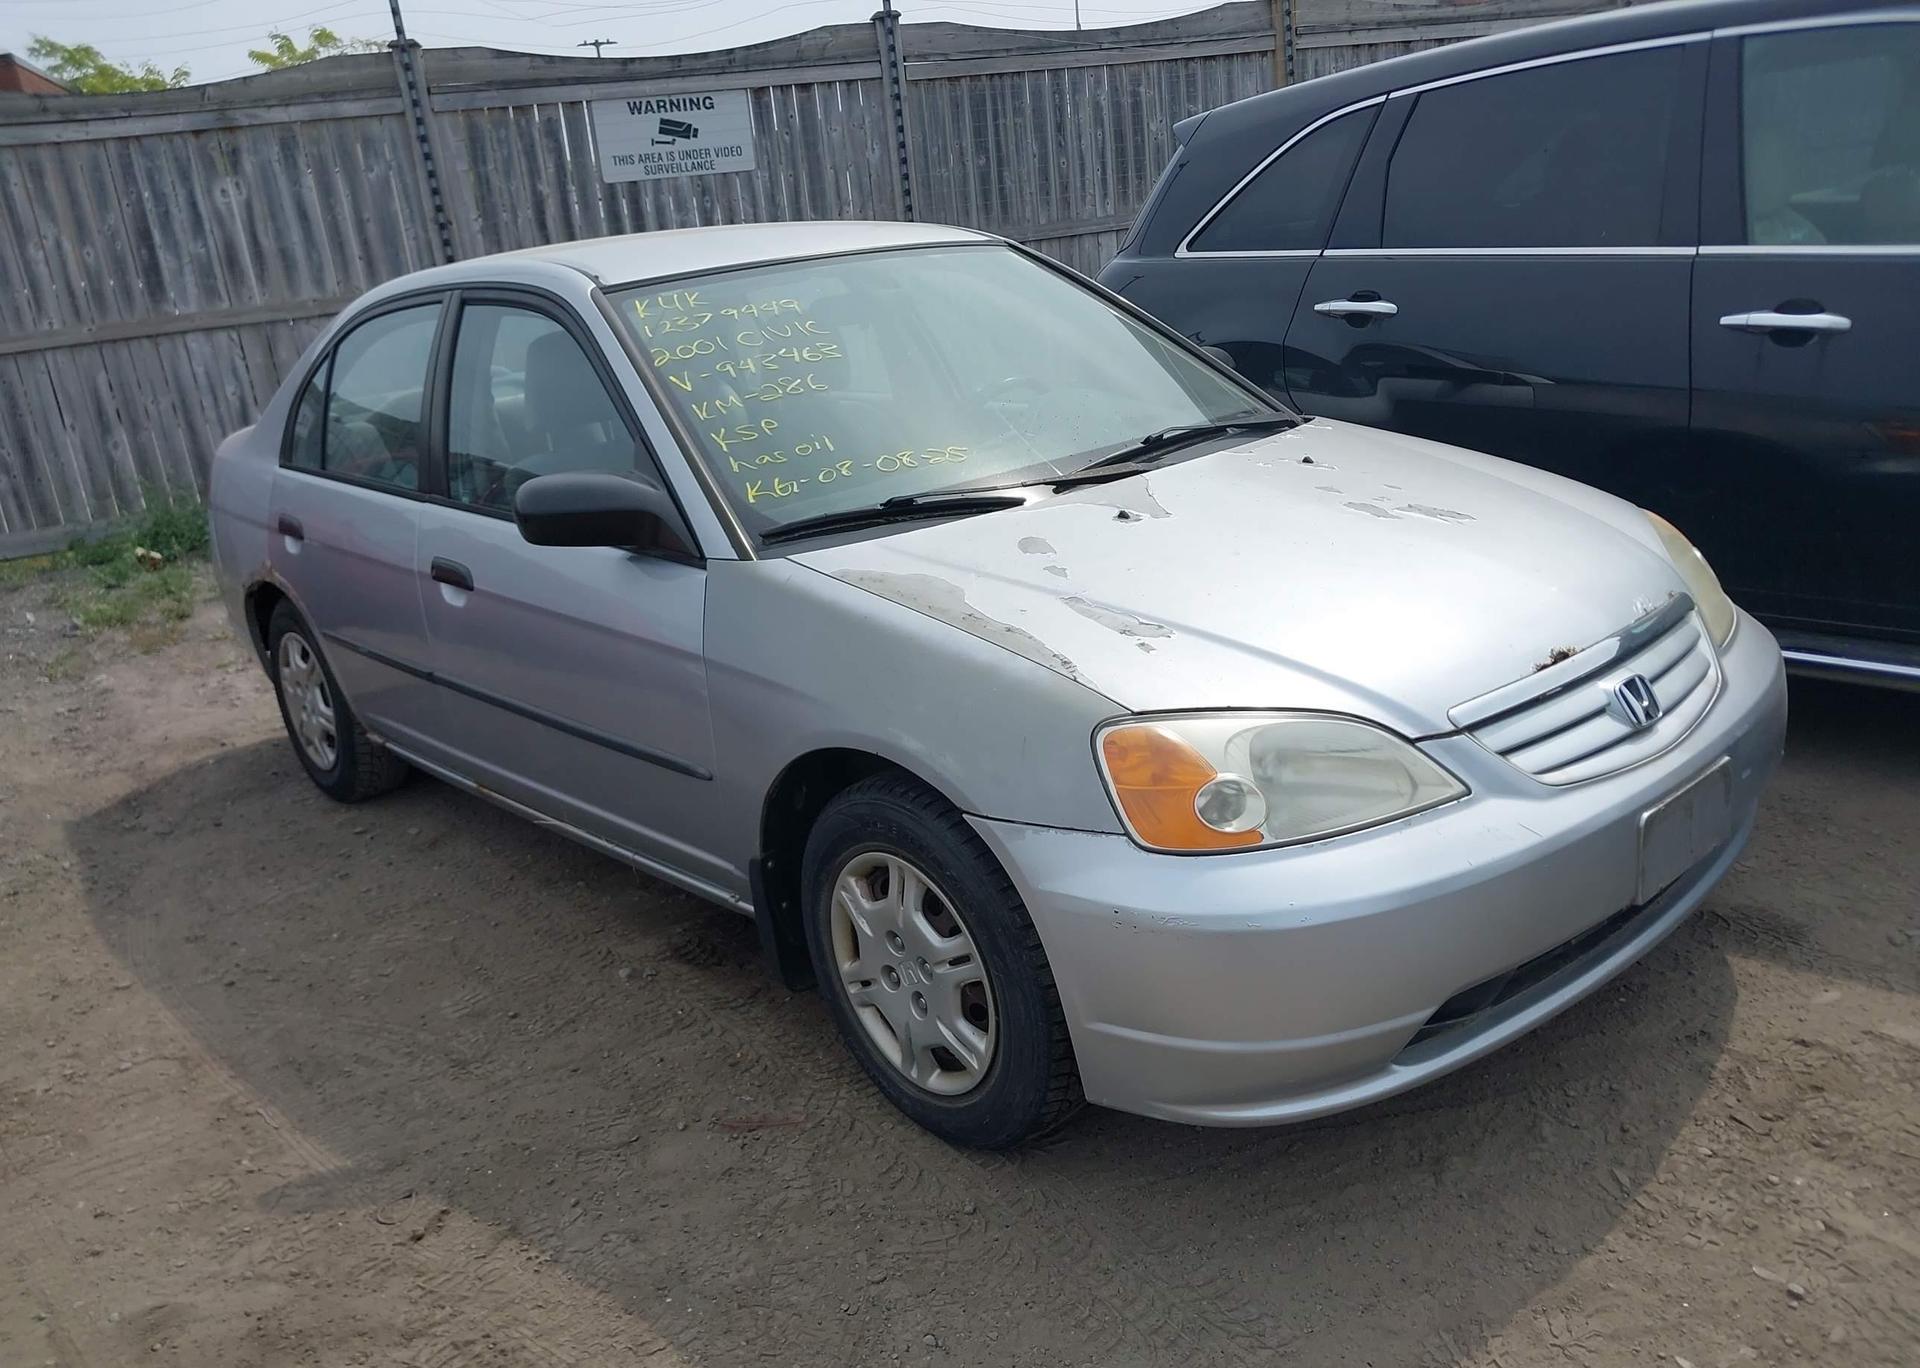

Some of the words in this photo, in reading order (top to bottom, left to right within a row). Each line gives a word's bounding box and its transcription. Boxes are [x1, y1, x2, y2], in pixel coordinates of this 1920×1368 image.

[627, 96, 715, 115] WARNING
[612, 154, 635, 166] THIS
[638, 151, 663, 164] AREA
[666, 150, 675, 162] IS
[679, 148, 712, 161] UNDER
[714, 146, 743, 158] VIDEO
[644, 160, 716, 176] SURVEILLANCE
[650, 336, 728, 367] 2001
[736, 320, 832, 346] CIVIC
[728, 451, 789, 473] has
[795, 433, 835, 456] oil
